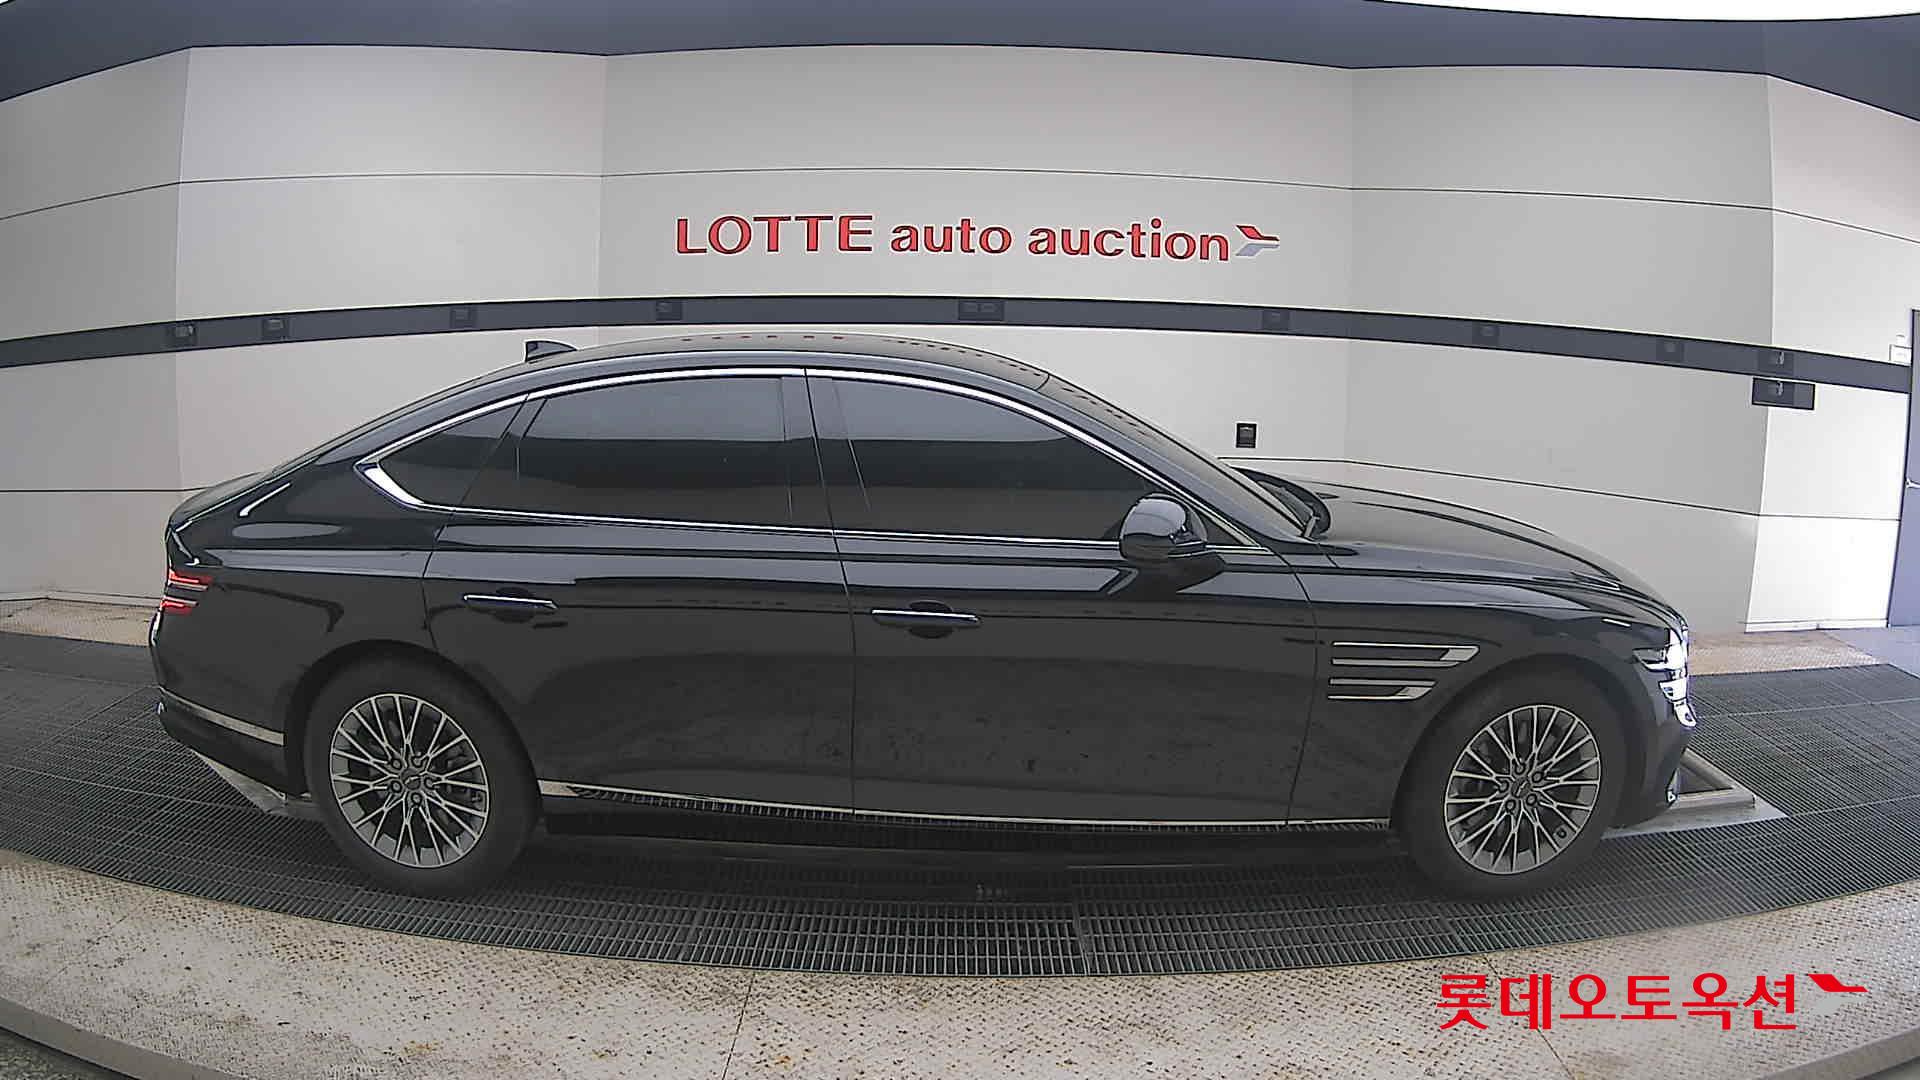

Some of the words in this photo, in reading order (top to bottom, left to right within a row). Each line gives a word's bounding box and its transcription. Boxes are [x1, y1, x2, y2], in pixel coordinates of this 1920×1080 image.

[676, 215, 873, 254] LOTTE
[890, 218, 1012, 254] auto
[1028, 218, 1230, 261] auction
